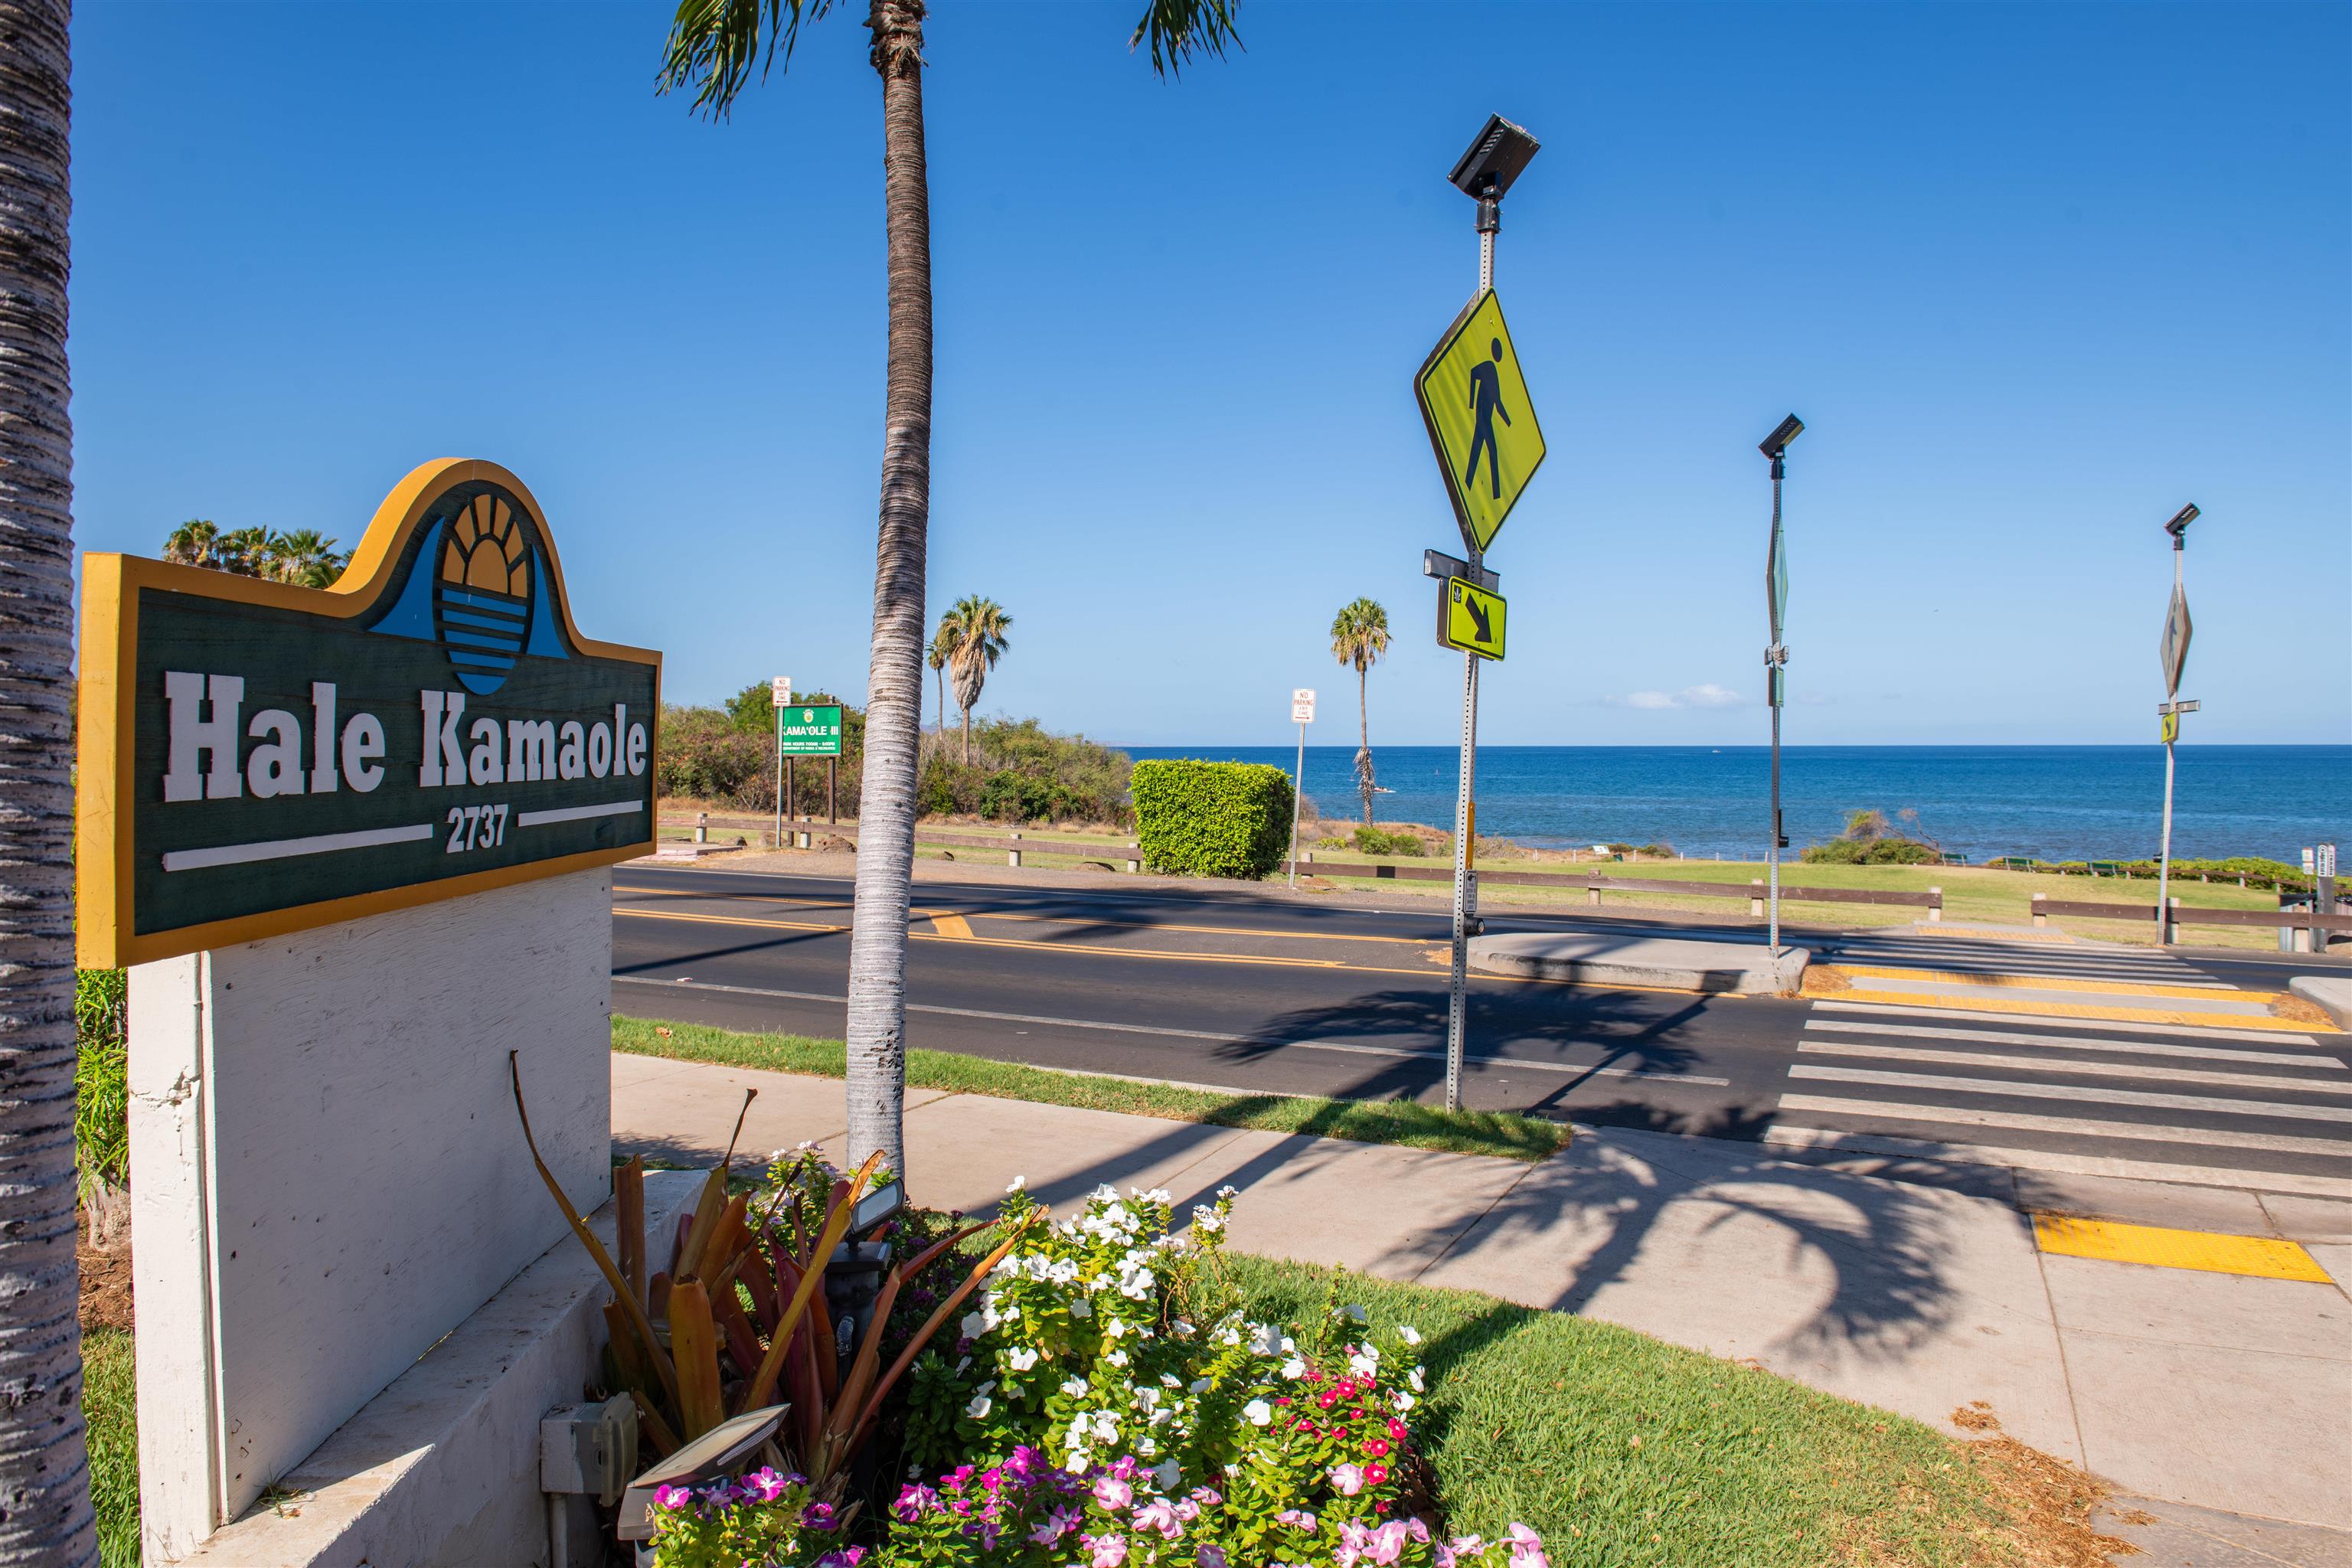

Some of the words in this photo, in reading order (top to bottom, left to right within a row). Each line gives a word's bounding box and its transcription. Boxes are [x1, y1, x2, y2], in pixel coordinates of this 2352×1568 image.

[163, 671, 385, 802] Hale
[420, 690, 647, 788] Kamaole
[446, 805, 508, 854] 2737
